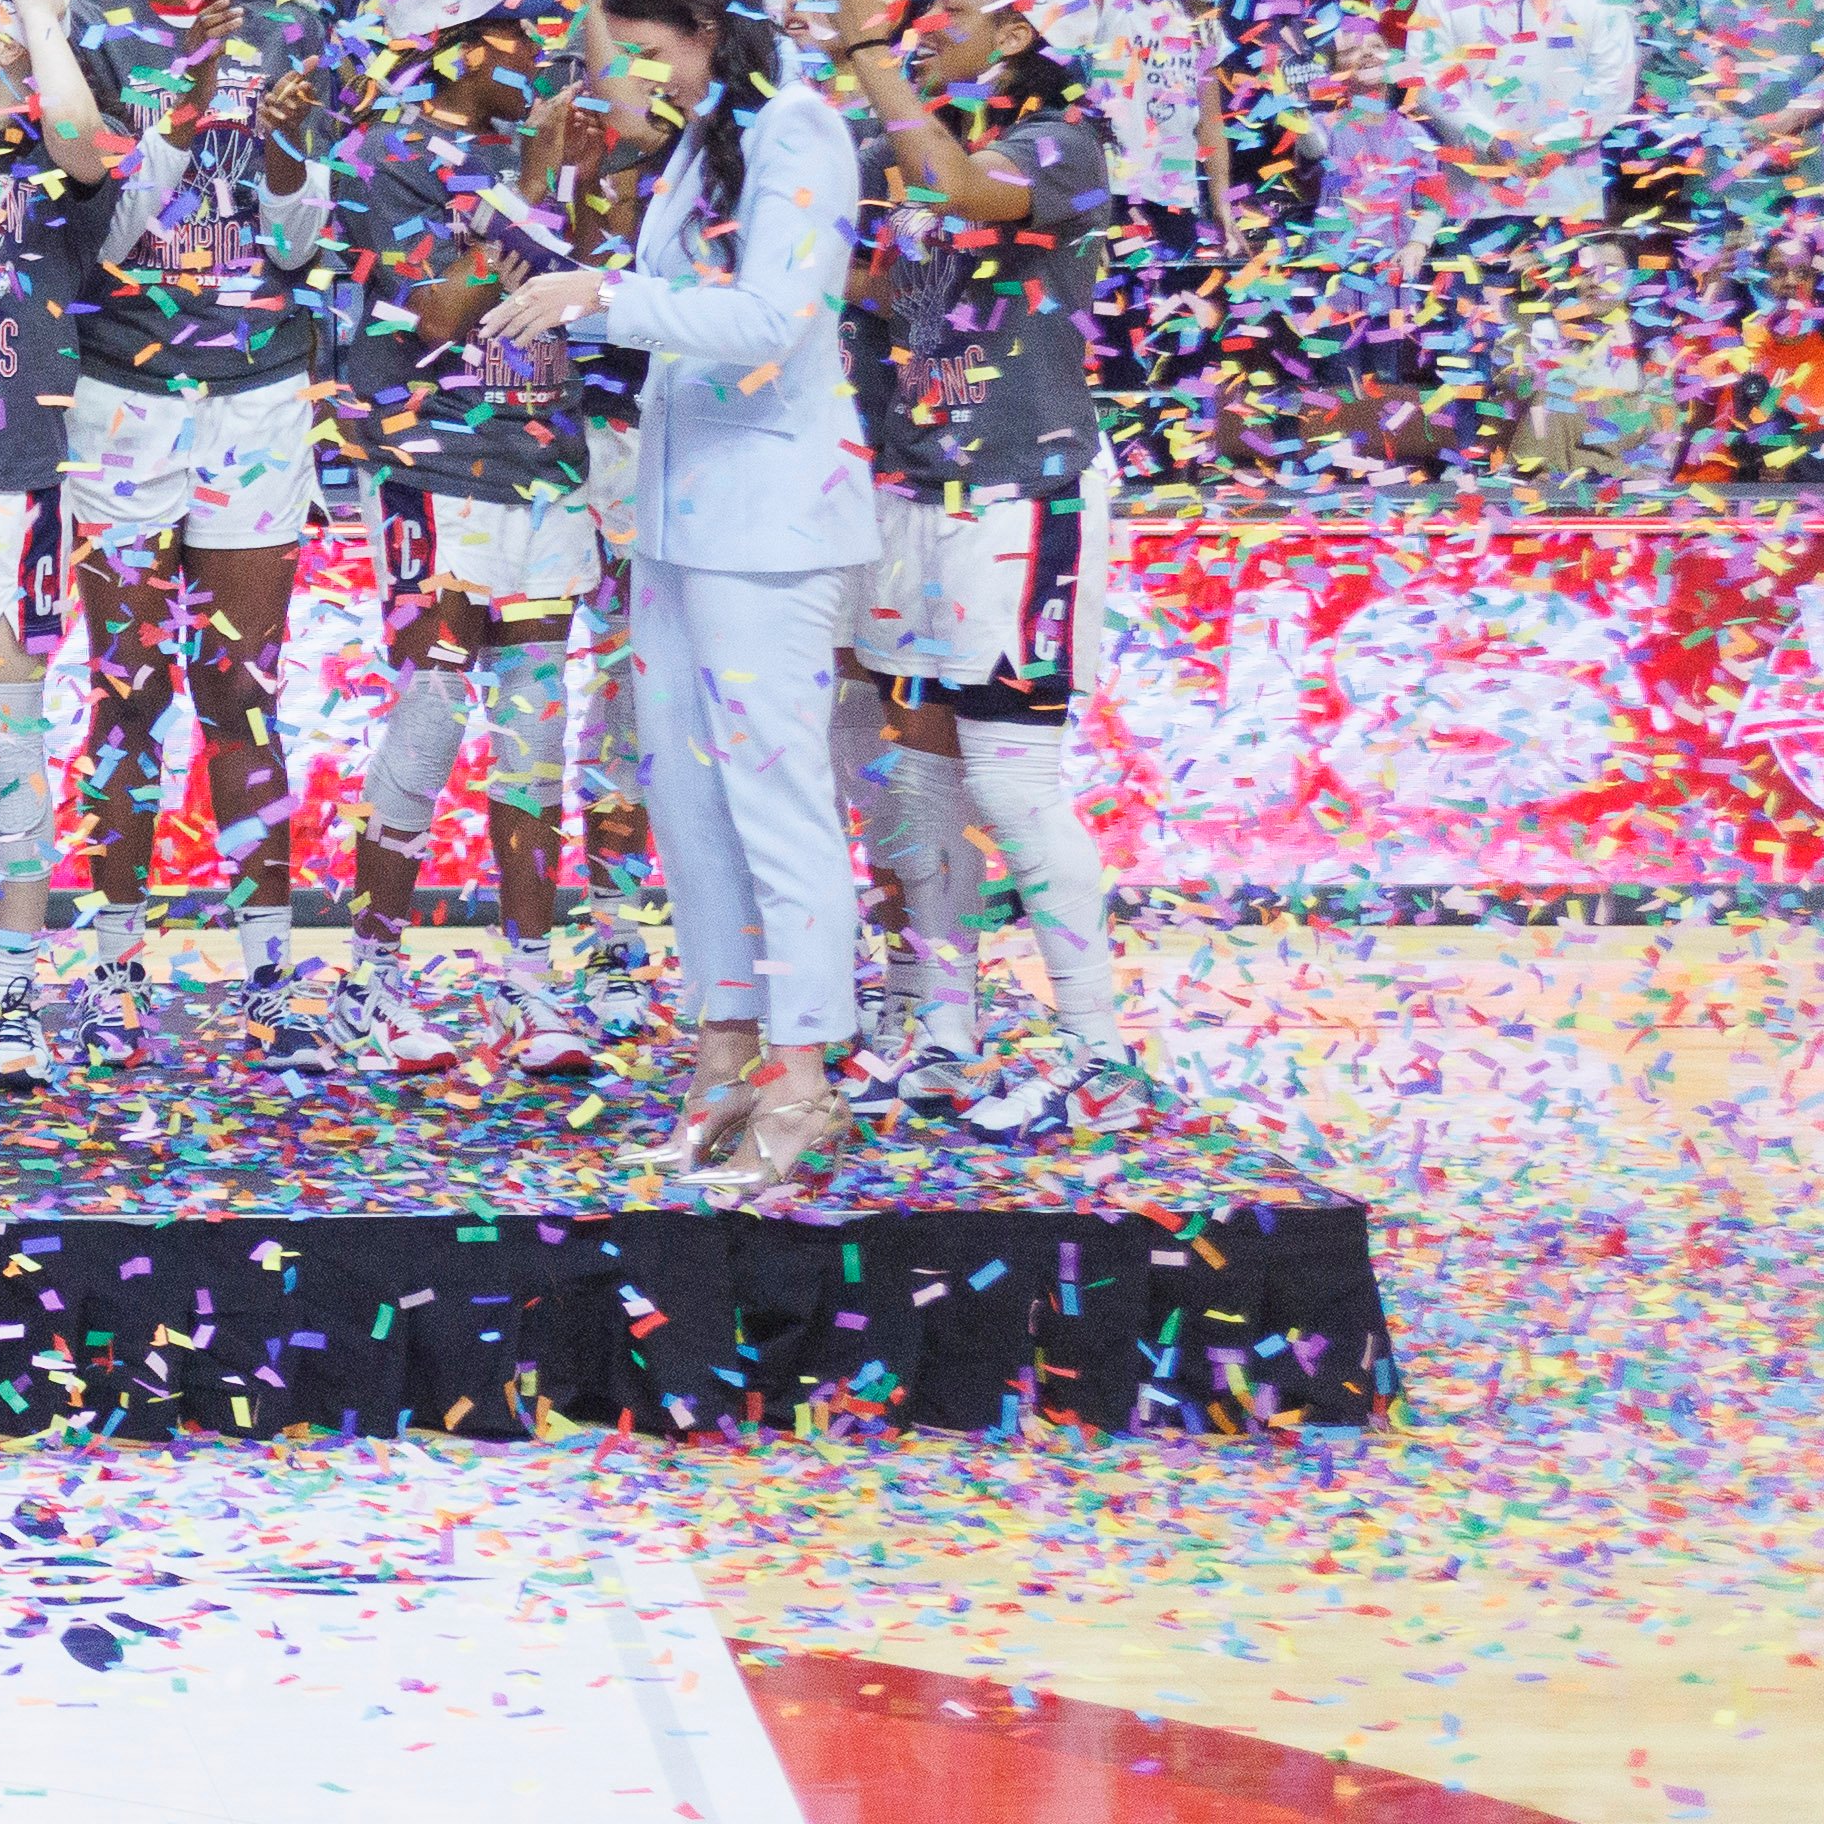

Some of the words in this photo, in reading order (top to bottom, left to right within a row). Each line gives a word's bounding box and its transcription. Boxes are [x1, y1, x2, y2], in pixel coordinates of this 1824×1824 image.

[484, 390, 506, 404] 25
[401, 520, 422, 580] C
[34, 555, 53, 616] C
[1035, 599, 1066, 661] C
